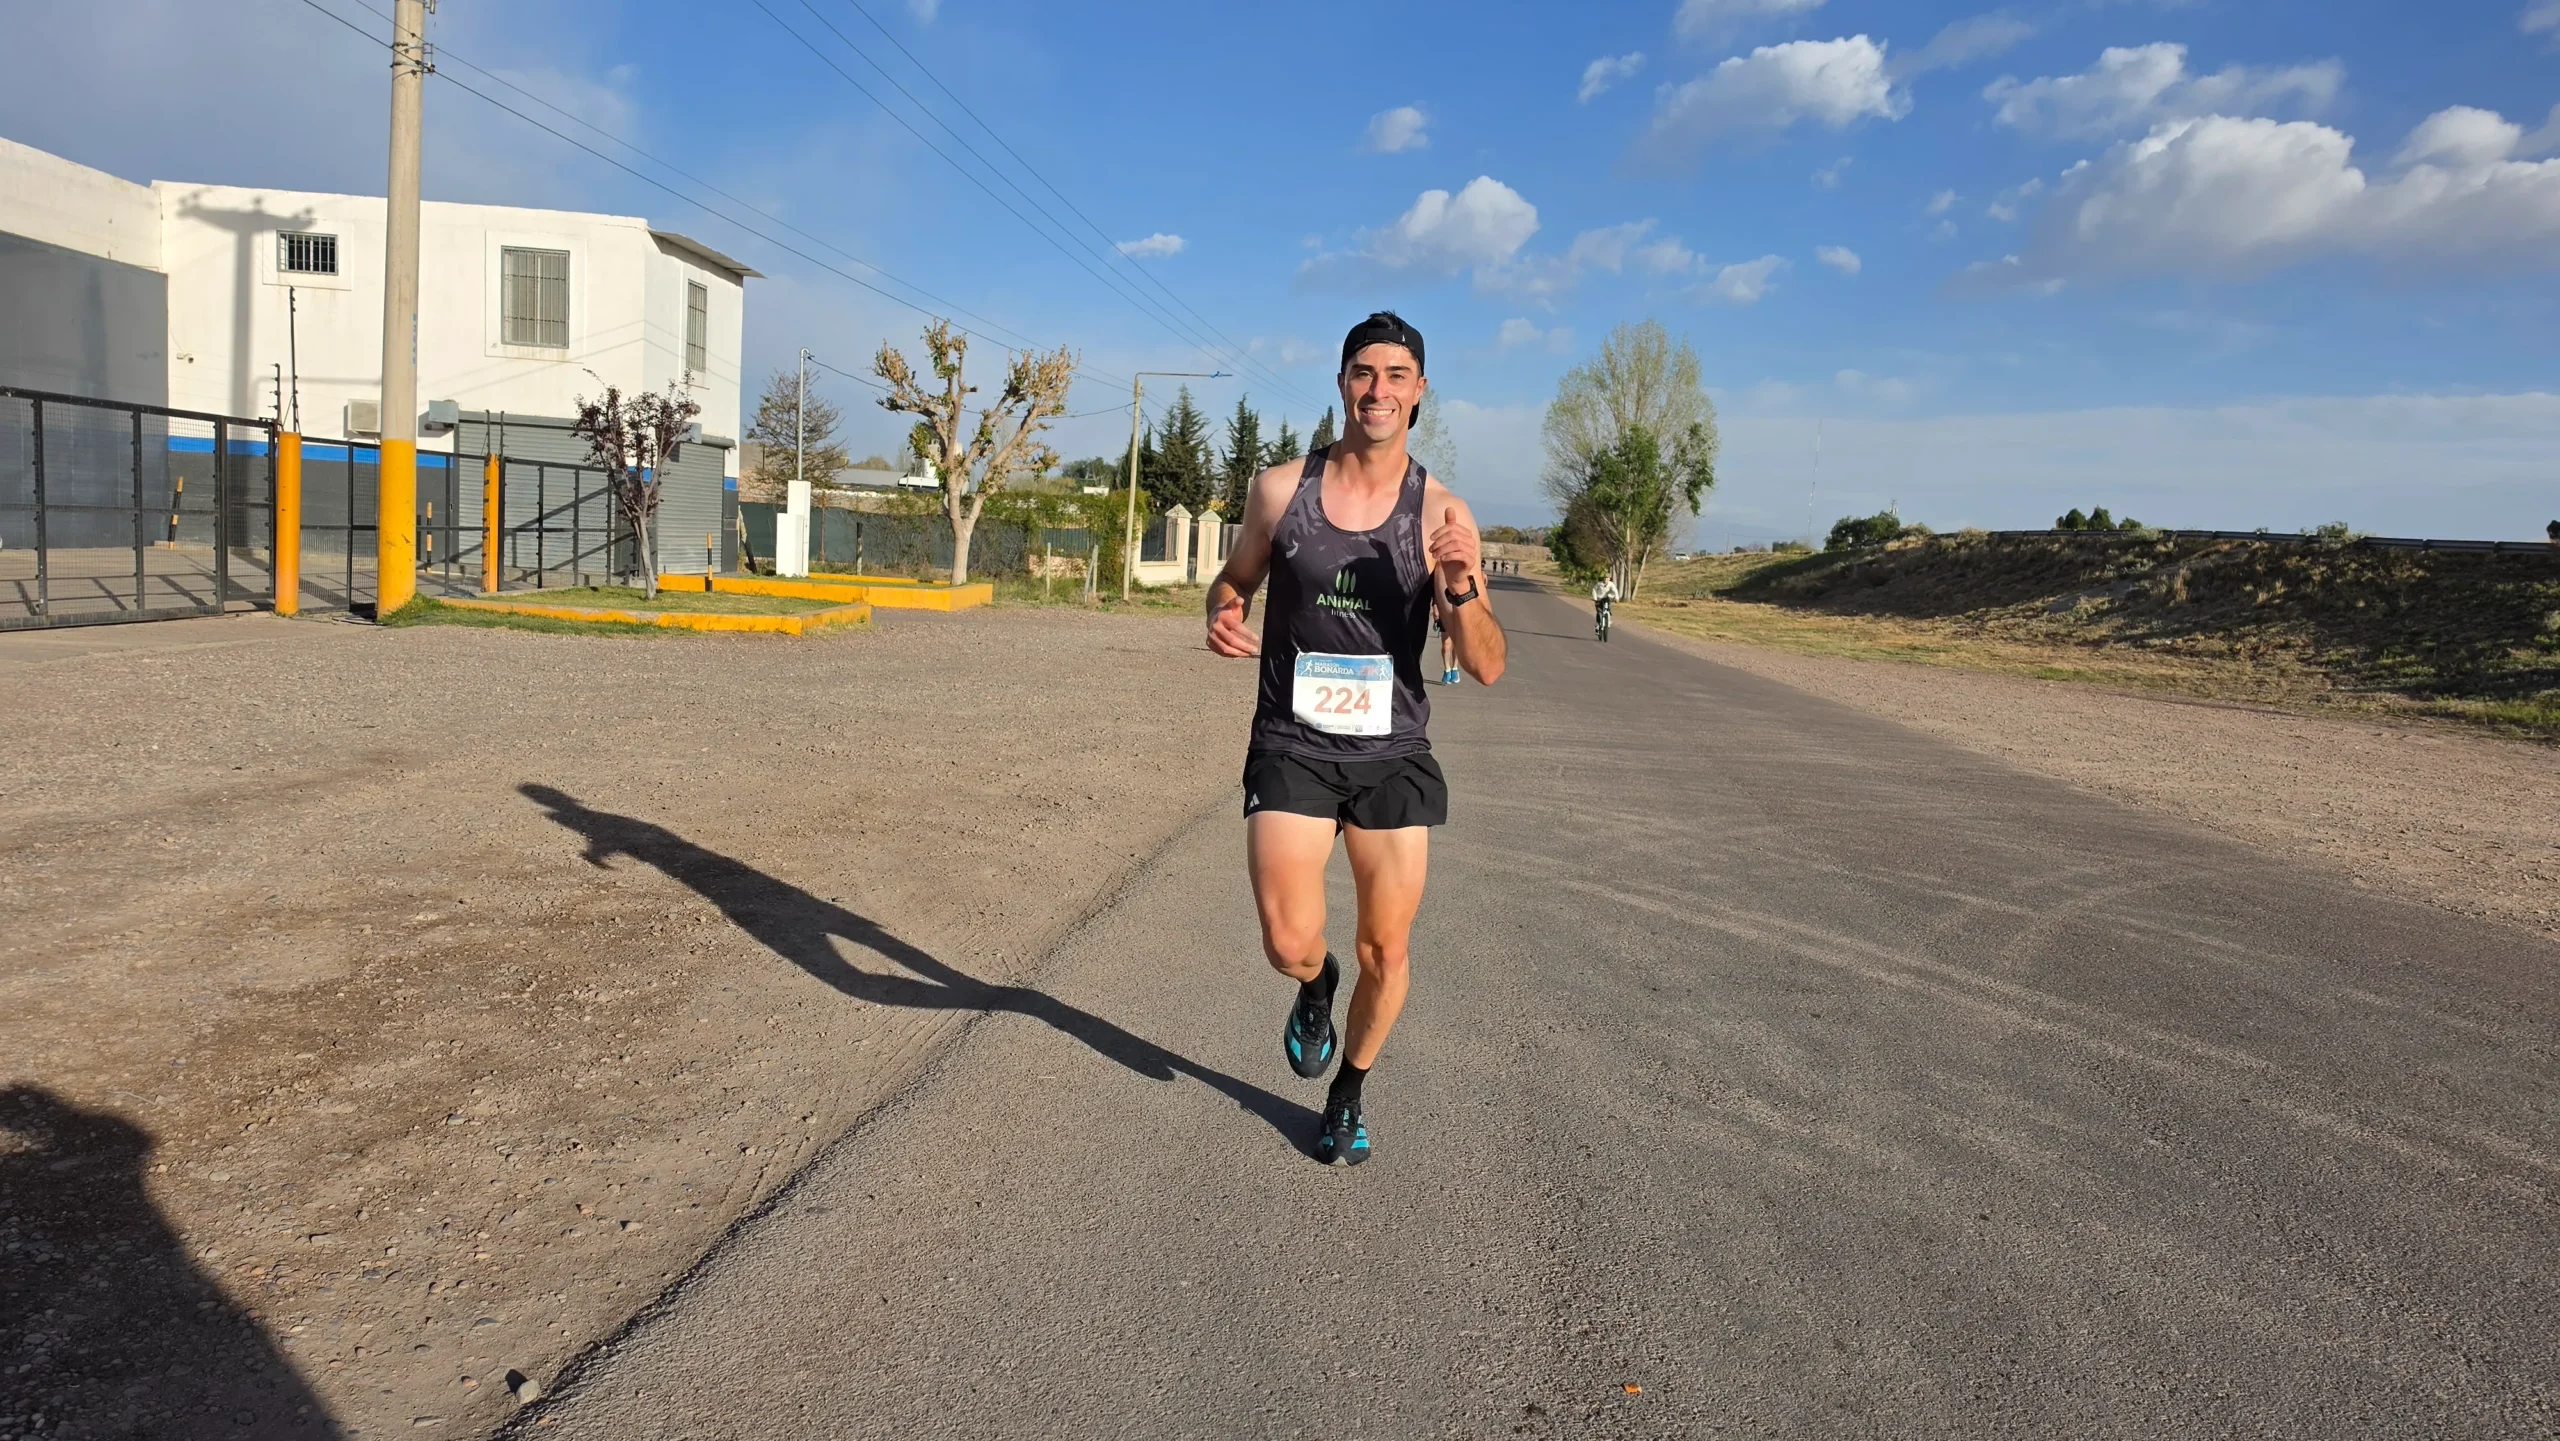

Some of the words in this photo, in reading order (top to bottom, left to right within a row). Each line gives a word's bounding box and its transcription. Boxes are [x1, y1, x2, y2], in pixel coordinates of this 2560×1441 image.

[1316, 593, 1372, 610] ANIMAL
[1314, 666, 1355, 675] BONARDA
[1314, 686, 1371, 714] 224
